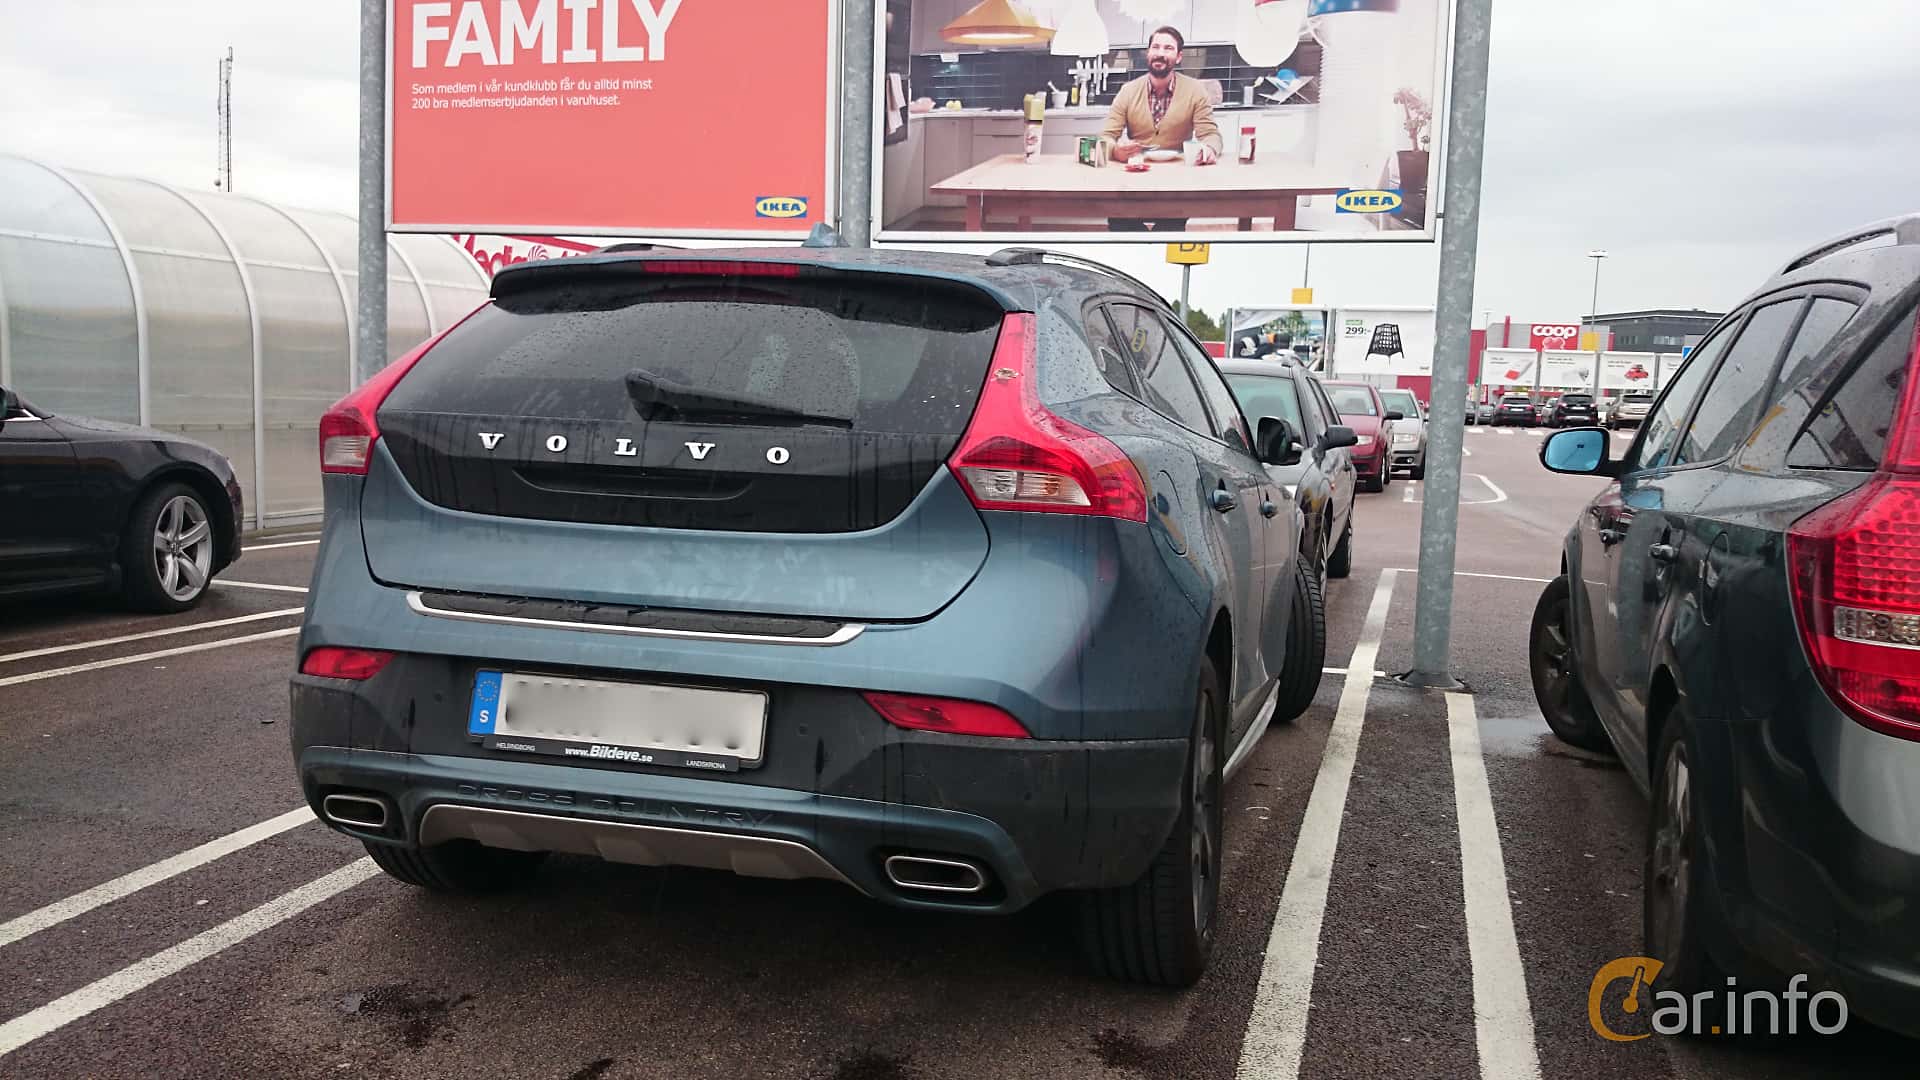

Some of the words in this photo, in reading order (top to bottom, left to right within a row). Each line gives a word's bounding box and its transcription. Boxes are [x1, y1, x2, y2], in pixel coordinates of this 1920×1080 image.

[412, 0, 682, 68] FAMILY
[411, 83, 435, 95] Som
[437, 82, 477, 94] medlem
[486, 78, 502, 93] vår
[504, 80, 558, 92] kundklubb
[560, 77, 575, 91] får
[578, 79, 592, 91] du
[594, 78, 619, 91] alltid
[622, 78, 653, 90] minst
[411, 98, 431, 109] 200
[433, 97, 449, 109] bra
[451, 95, 558, 109] medlemserbjudanden
[566, 94, 621, 106] varuhuset.
[763, 203, 801, 211] IKEA
[1345, 196, 1394, 206] IKEA
[1532, 325, 1577, 339] coop
[479, 432, 790, 465] VOLVO
[479, 710, 489, 723] S
[565, 745, 653, 763] www.Bildeve.se
[457, 784, 574, 806] CROSS
[591, 799, 775, 828] COUNTRY
